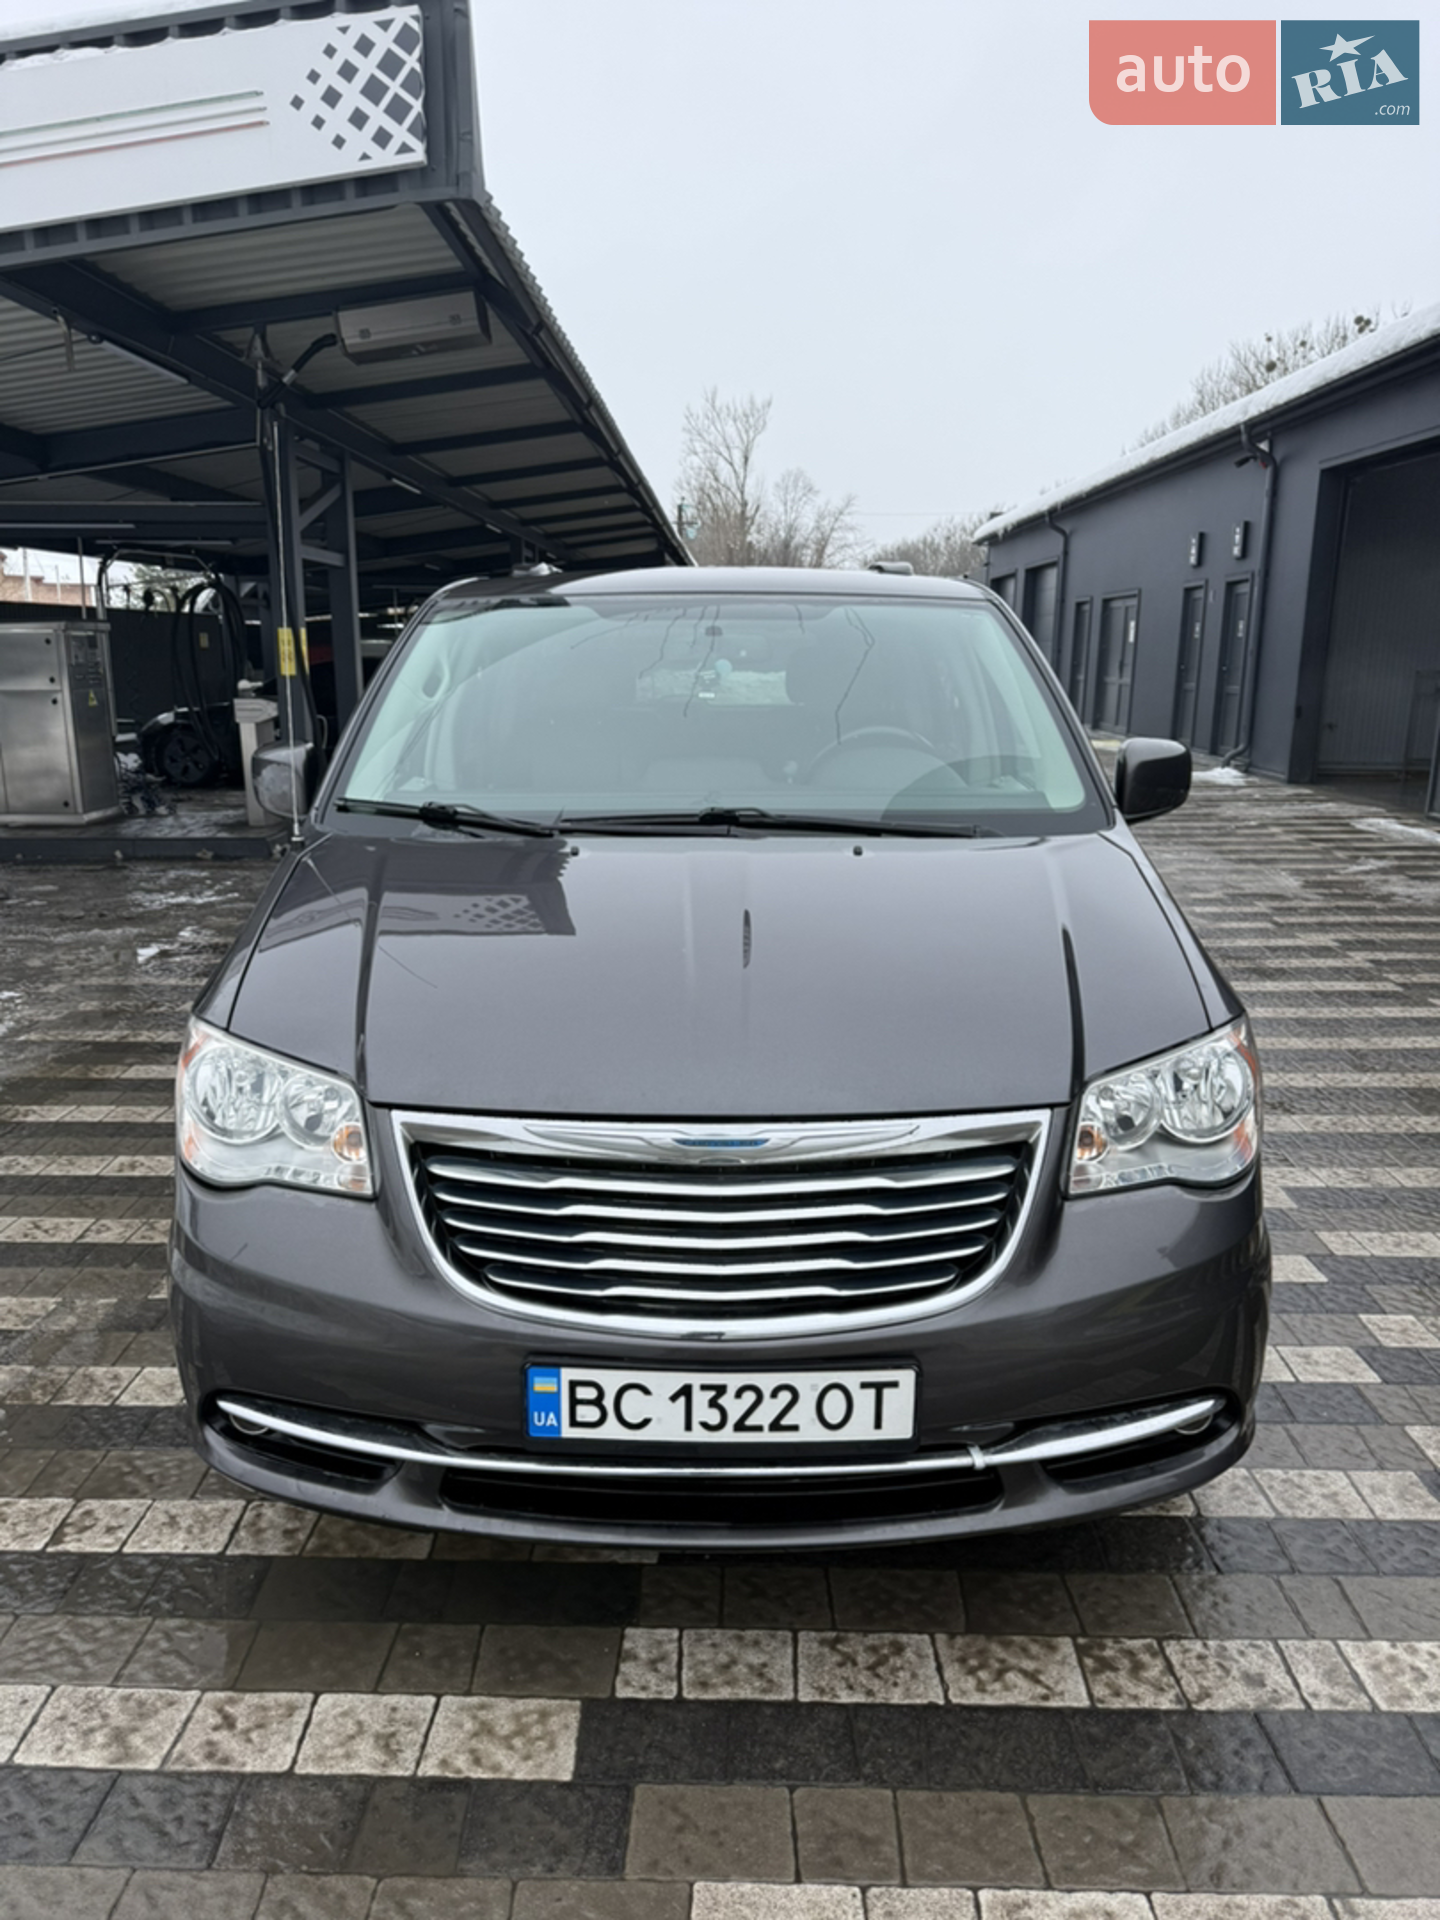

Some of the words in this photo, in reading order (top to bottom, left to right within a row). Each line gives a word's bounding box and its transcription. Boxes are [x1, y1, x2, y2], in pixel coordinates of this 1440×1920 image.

[533, 1411, 558, 1427] UA
[568, 1379, 653, 1430] BC
[668, 1383, 801, 1432] 1322
[815, 1380, 900, 1431] OT
